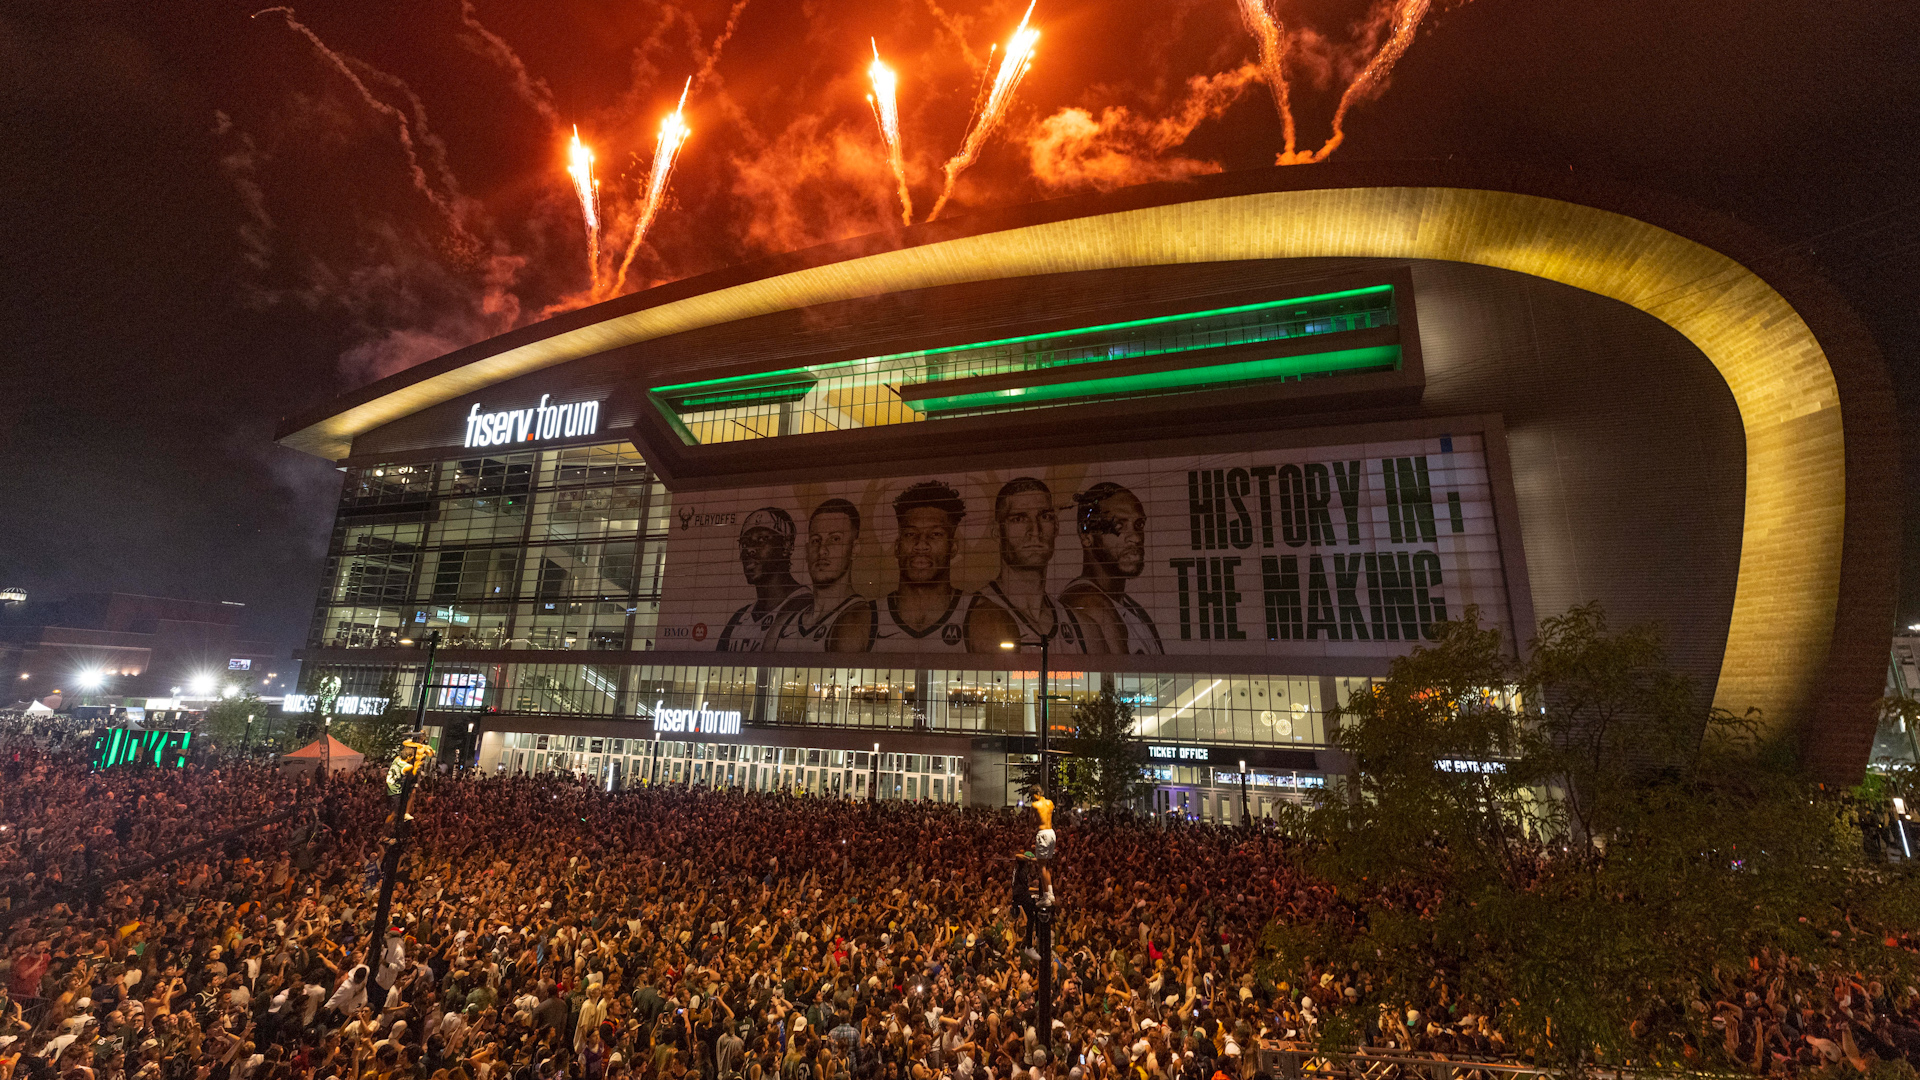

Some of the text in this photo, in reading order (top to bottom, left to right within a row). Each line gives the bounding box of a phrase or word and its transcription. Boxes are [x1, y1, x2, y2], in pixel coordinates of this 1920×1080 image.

[1188, 456, 1438, 550] HISTORY IN
[694, 513, 736, 526] PLAYOFFS
[1170, 549, 1448, 642] THE MAKING
[664, 627, 689, 637] BMO
[282, 693, 318, 713] BUCKS
[335, 696, 359, 714] PRO
[1148, 746, 1209, 760] TICKET OFFICE
